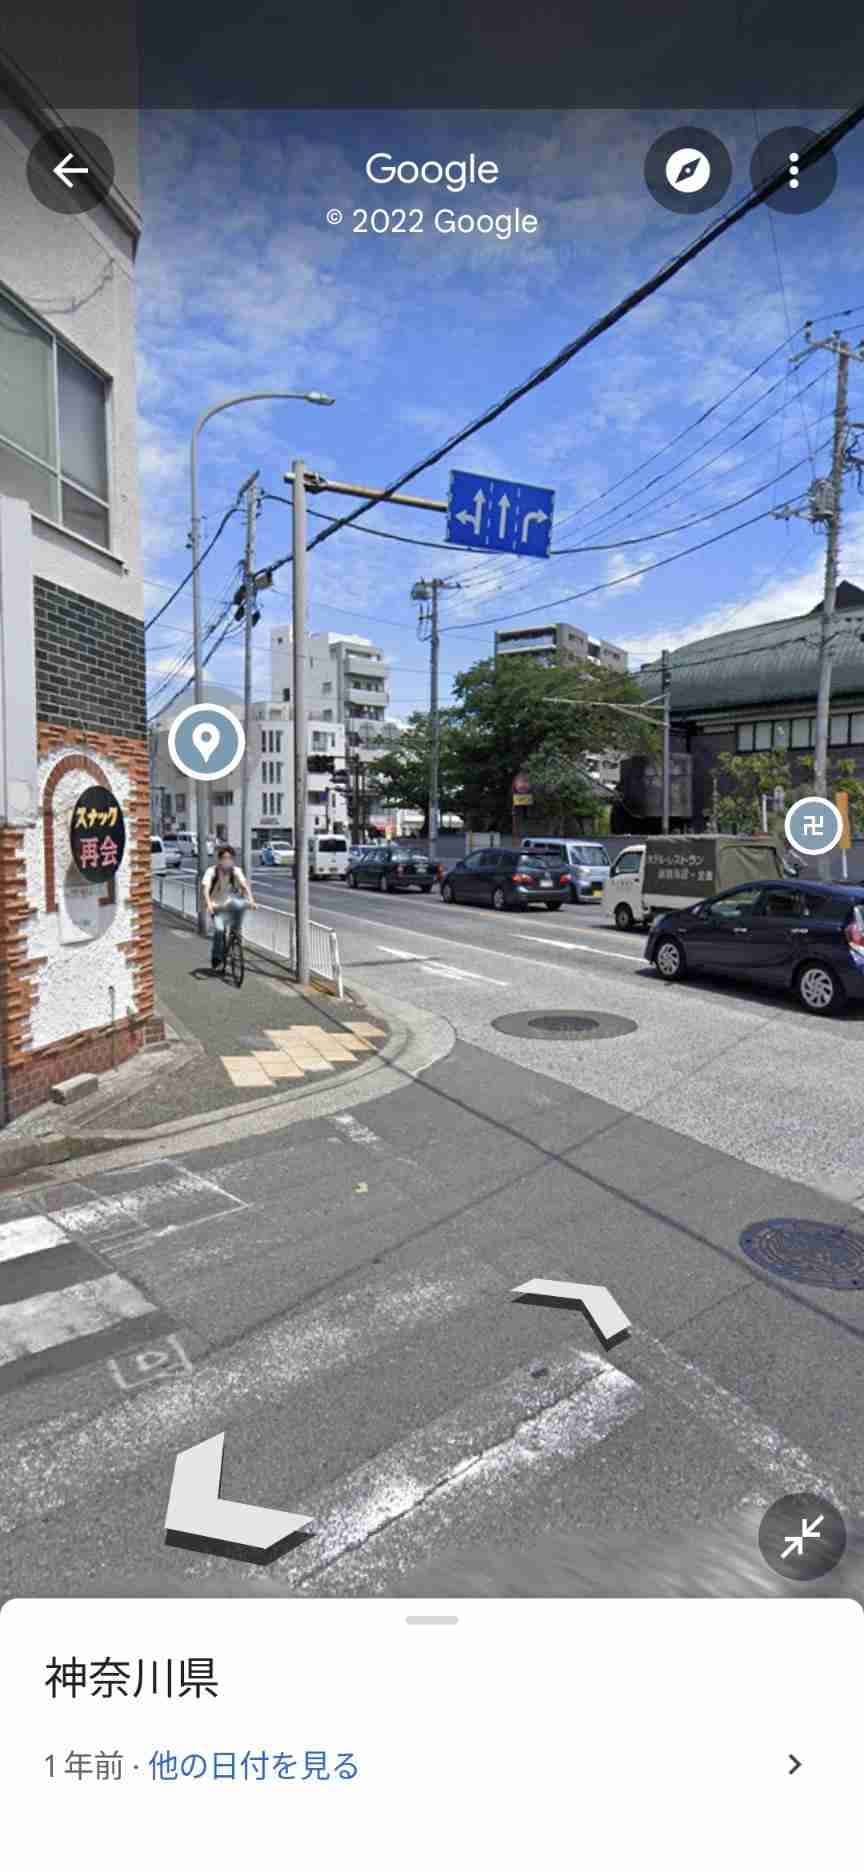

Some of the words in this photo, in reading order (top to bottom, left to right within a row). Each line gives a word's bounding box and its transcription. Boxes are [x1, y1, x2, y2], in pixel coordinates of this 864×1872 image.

[75, 807, 118, 829] スナック
[80, 836, 118, 868] 再会
